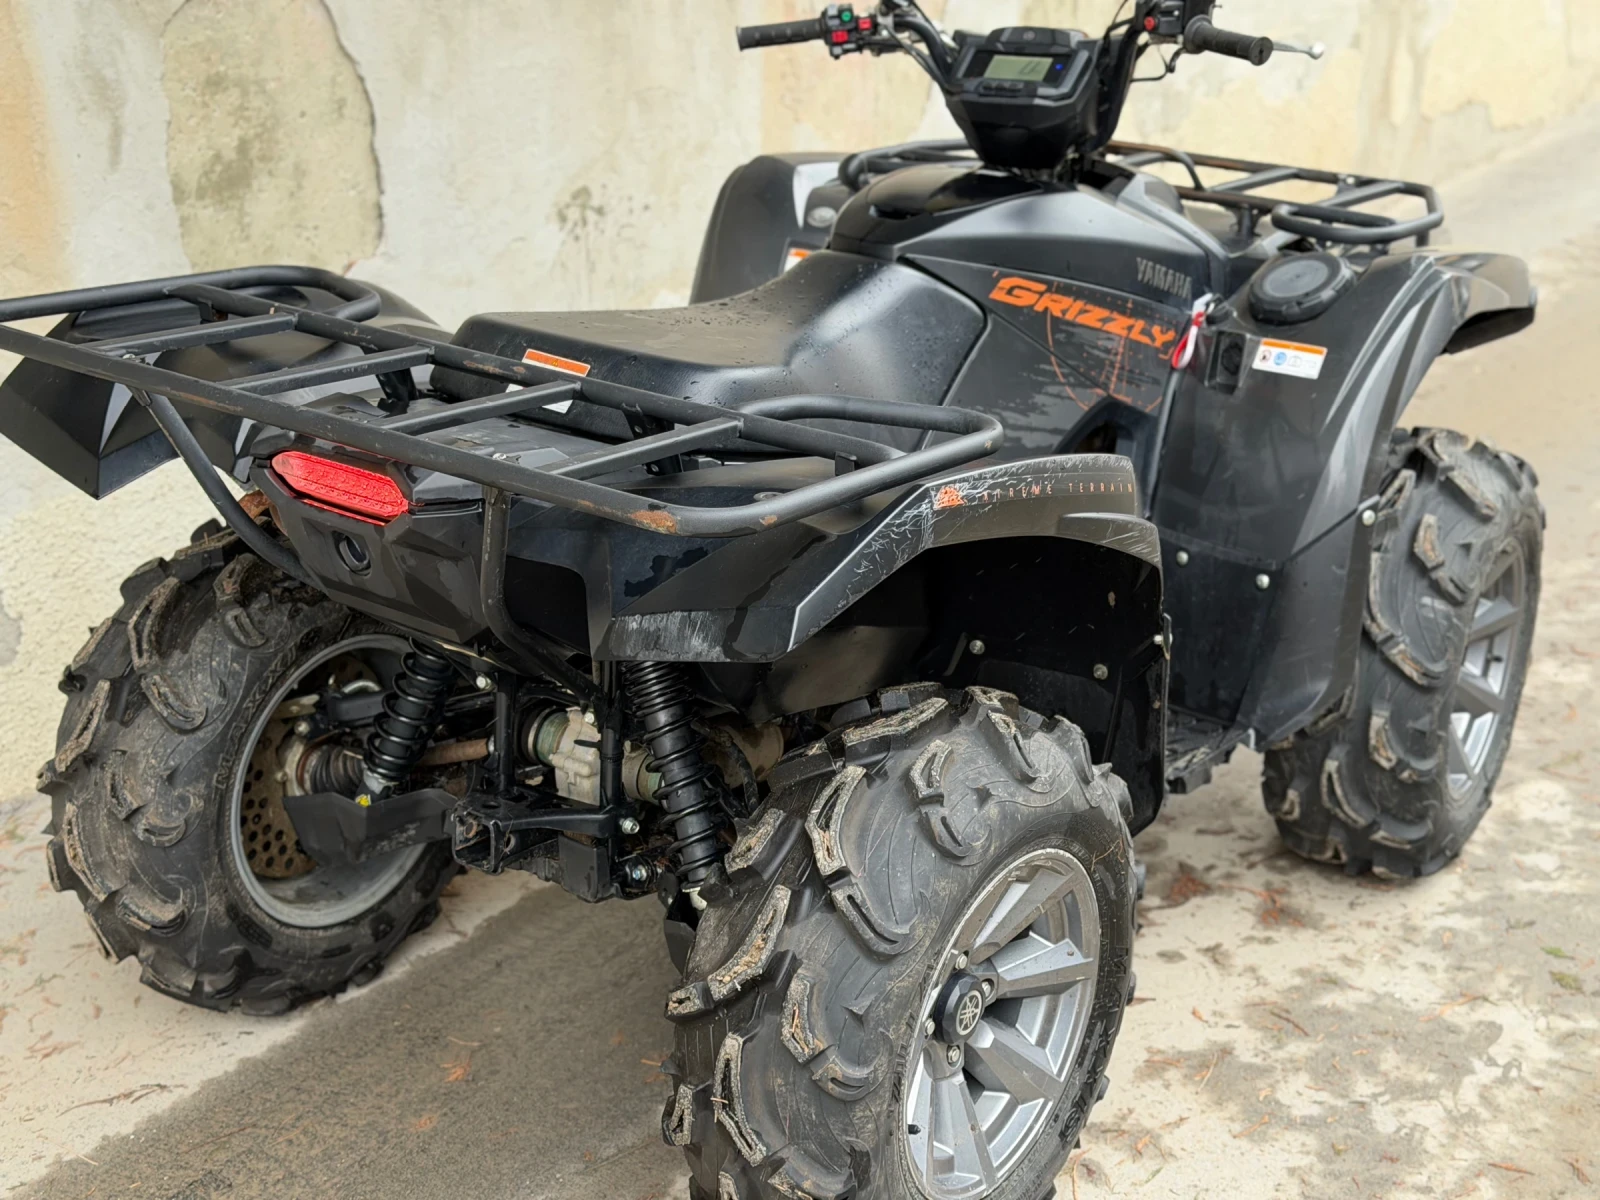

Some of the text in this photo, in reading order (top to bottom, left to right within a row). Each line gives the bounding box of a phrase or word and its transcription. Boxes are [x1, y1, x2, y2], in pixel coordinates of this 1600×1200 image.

[1136, 256, 1192, 300] YAMAHA
[988, 275, 1178, 349] GRIZZLY
[1068, 481, 1133, 494] TERRAIN
